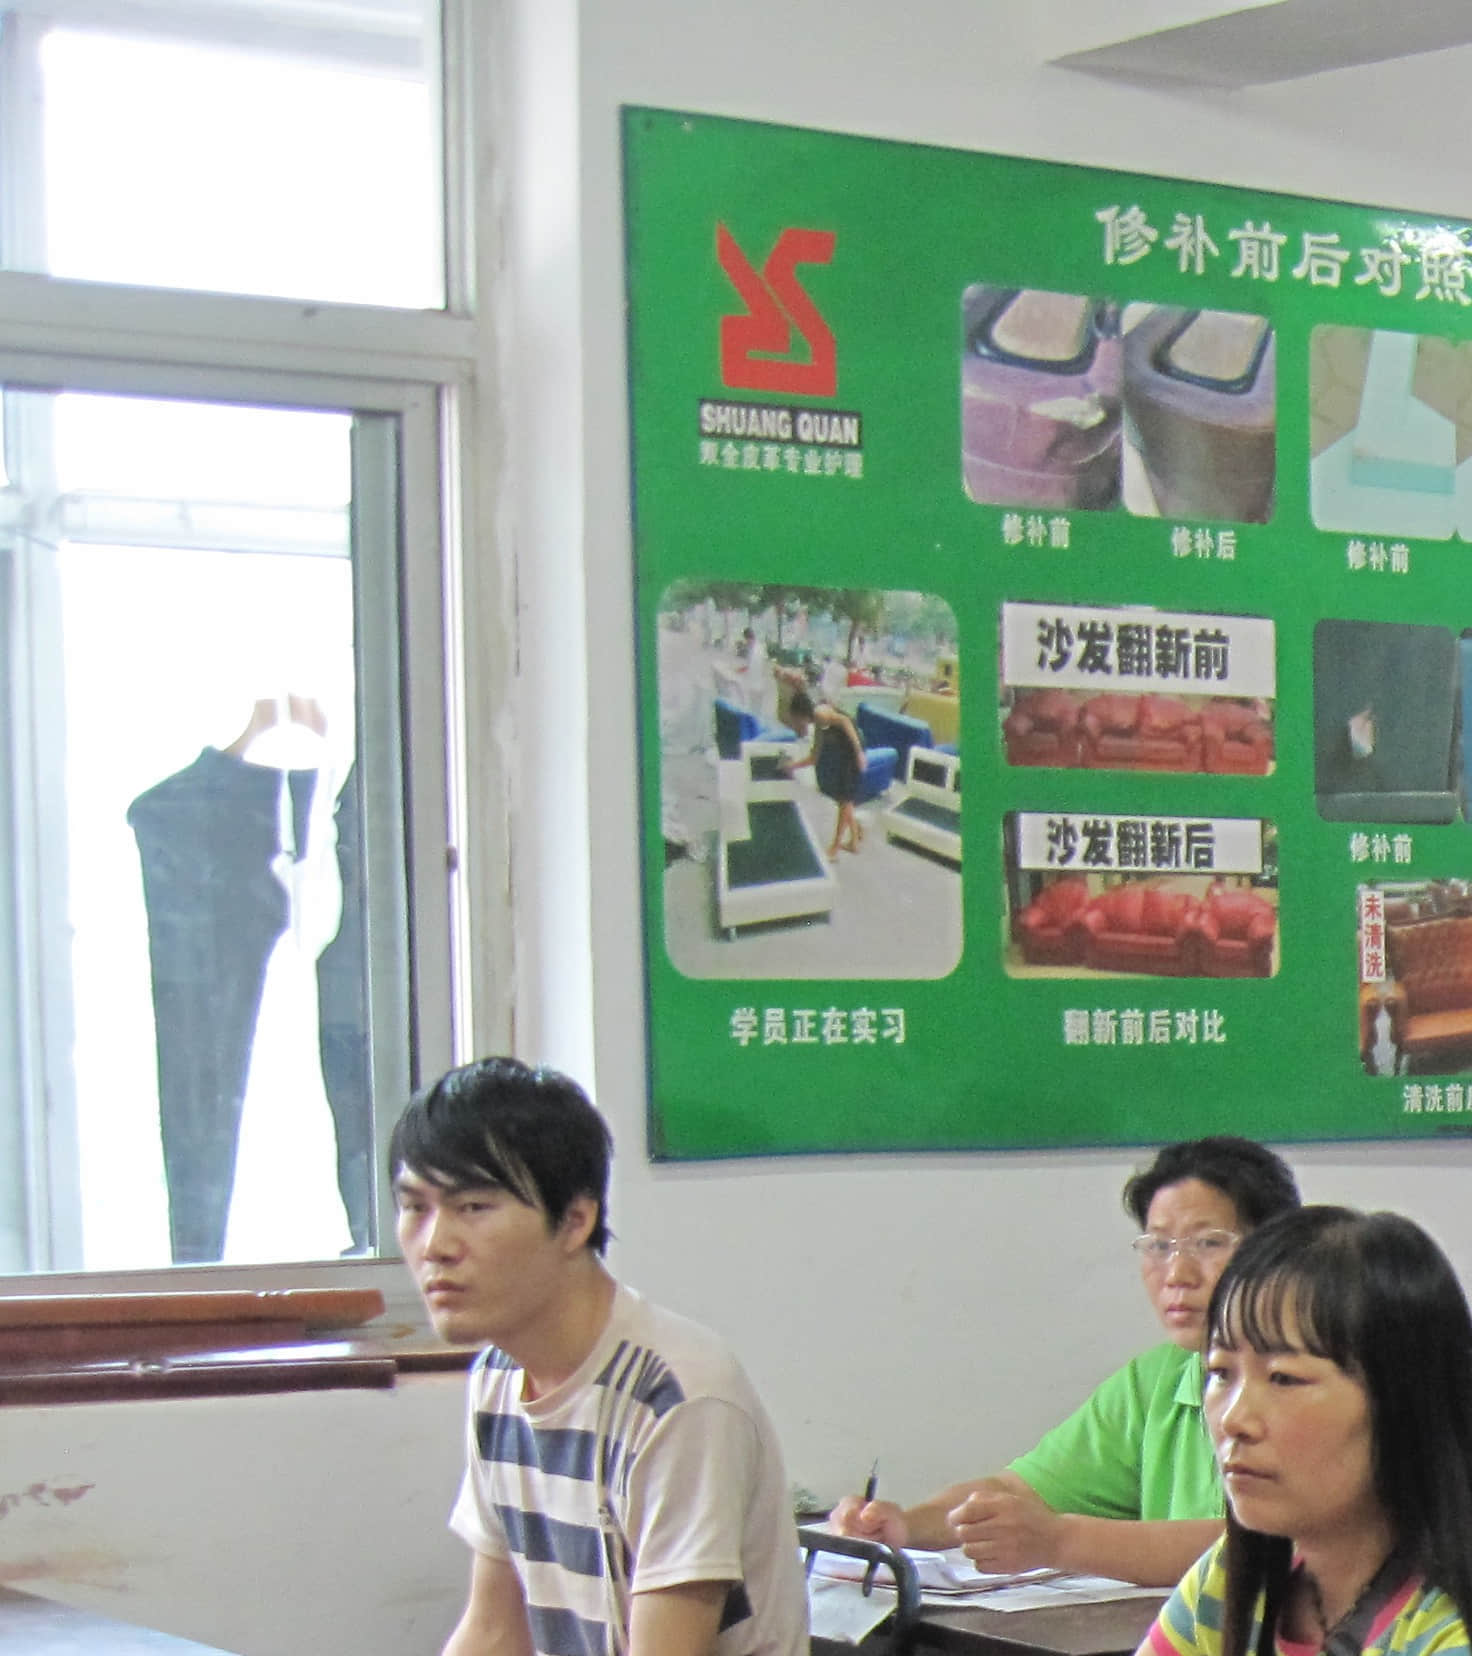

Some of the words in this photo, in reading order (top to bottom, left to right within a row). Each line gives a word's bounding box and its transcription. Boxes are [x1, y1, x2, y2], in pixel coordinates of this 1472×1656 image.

[1097, 206, 1472, 304] 修补前后对照
[701, 403, 793, 439] SHUANG
[796, 413, 860, 444] QUAN
[1003, 513, 1071, 549] 修补前
[1171, 526, 1237, 560] 修补后
[1347, 539, 1410, 574] 修补前
[1037, 617, 1231, 680] 沙发翻新前
[1047, 817, 1216, 868] 沙发翻新后
[1350, 832, 1412, 864] 修补前
[1364, 894, 1384, 978] 未清洗
[730, 1007, 907, 1046] 学员正在实习
[1062, 1009, 1227, 1045] 翻新前后对比
